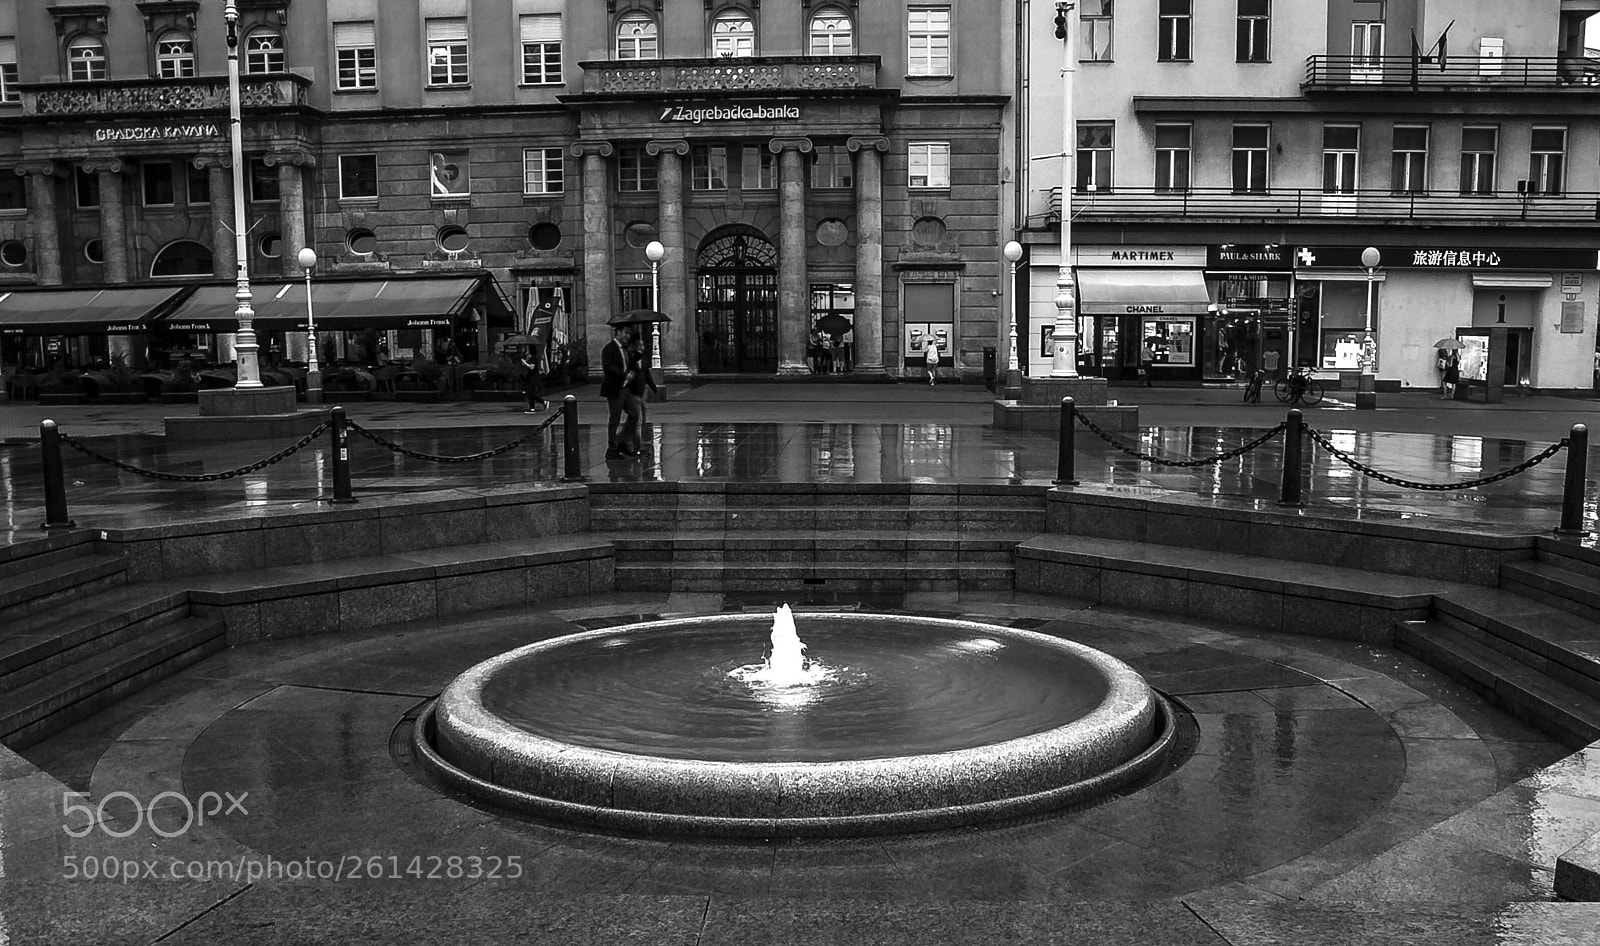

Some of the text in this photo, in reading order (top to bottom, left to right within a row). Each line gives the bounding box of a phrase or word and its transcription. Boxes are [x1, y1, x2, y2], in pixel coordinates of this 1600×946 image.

[674, 104, 800, 124] Zagrebačka banka
[95, 124, 219, 141] GRADSKA KAVANA
[1111, 250, 1175, 261] MARTIMEX
[1220, 252, 1241, 260] PAUL
[1250, 252, 1281, 260] SHARK
[1412, 249, 1501, 267] 旅游信息中心
[1125, 305, 1165, 313] CHANEL
